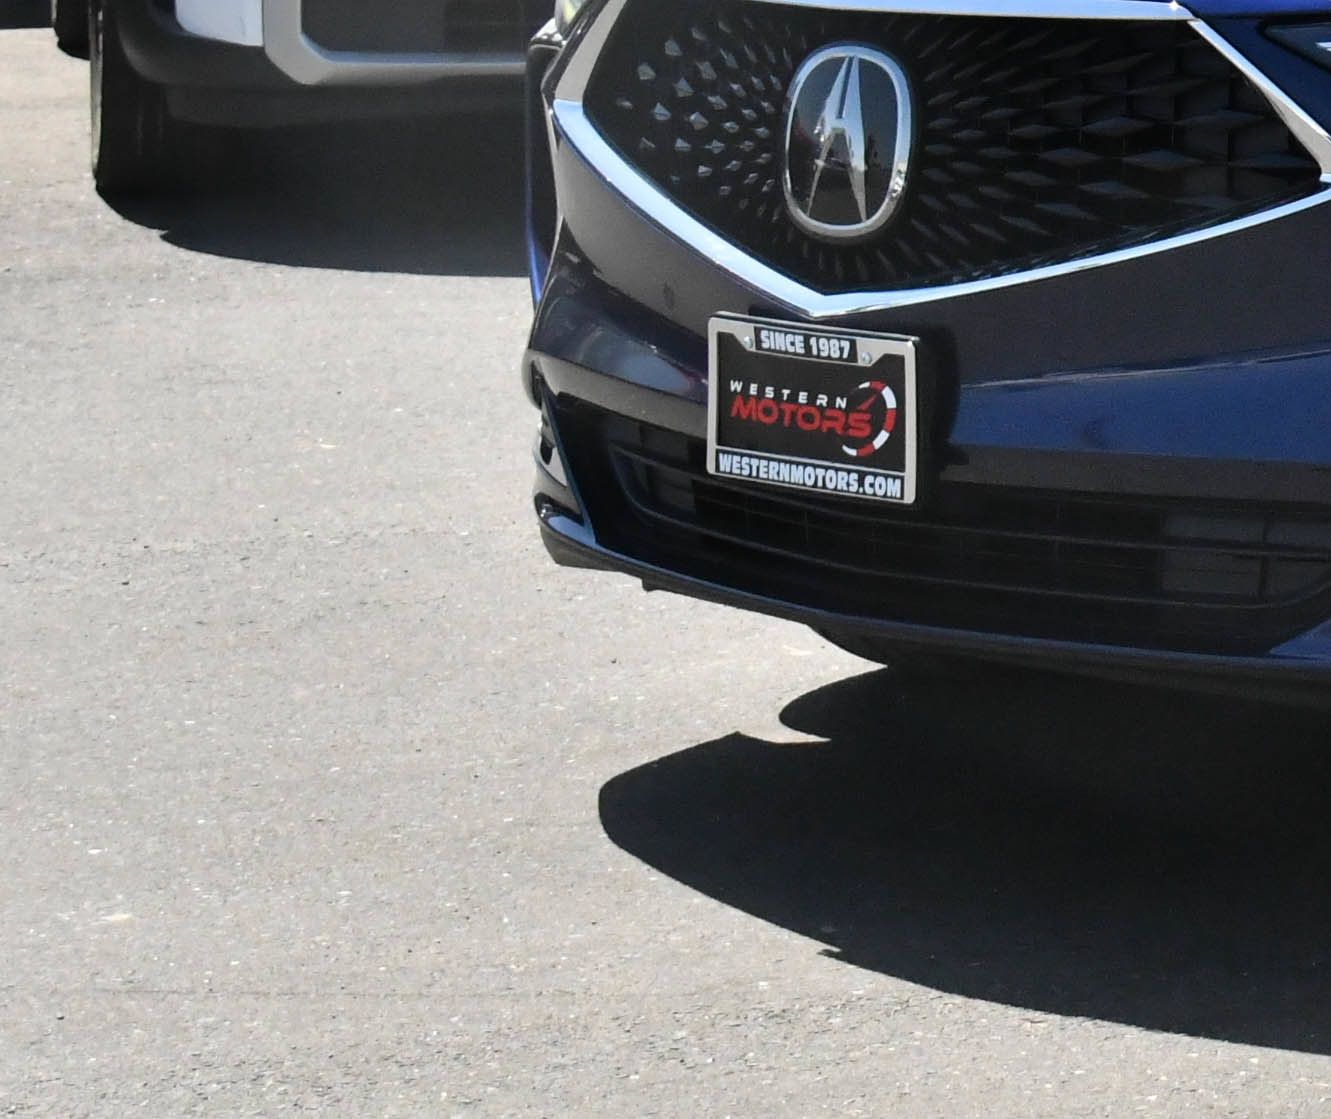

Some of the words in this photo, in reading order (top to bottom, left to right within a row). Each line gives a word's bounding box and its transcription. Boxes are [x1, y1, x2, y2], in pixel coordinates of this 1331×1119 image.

[760, 330, 805, 354] SINCE
[810, 337, 850, 359] 1987
[730, 380, 847, 408] WESTERN
[730, 395, 872, 438] MOTORS
[719, 452, 901, 498] WESTERNMOTORS.COM
